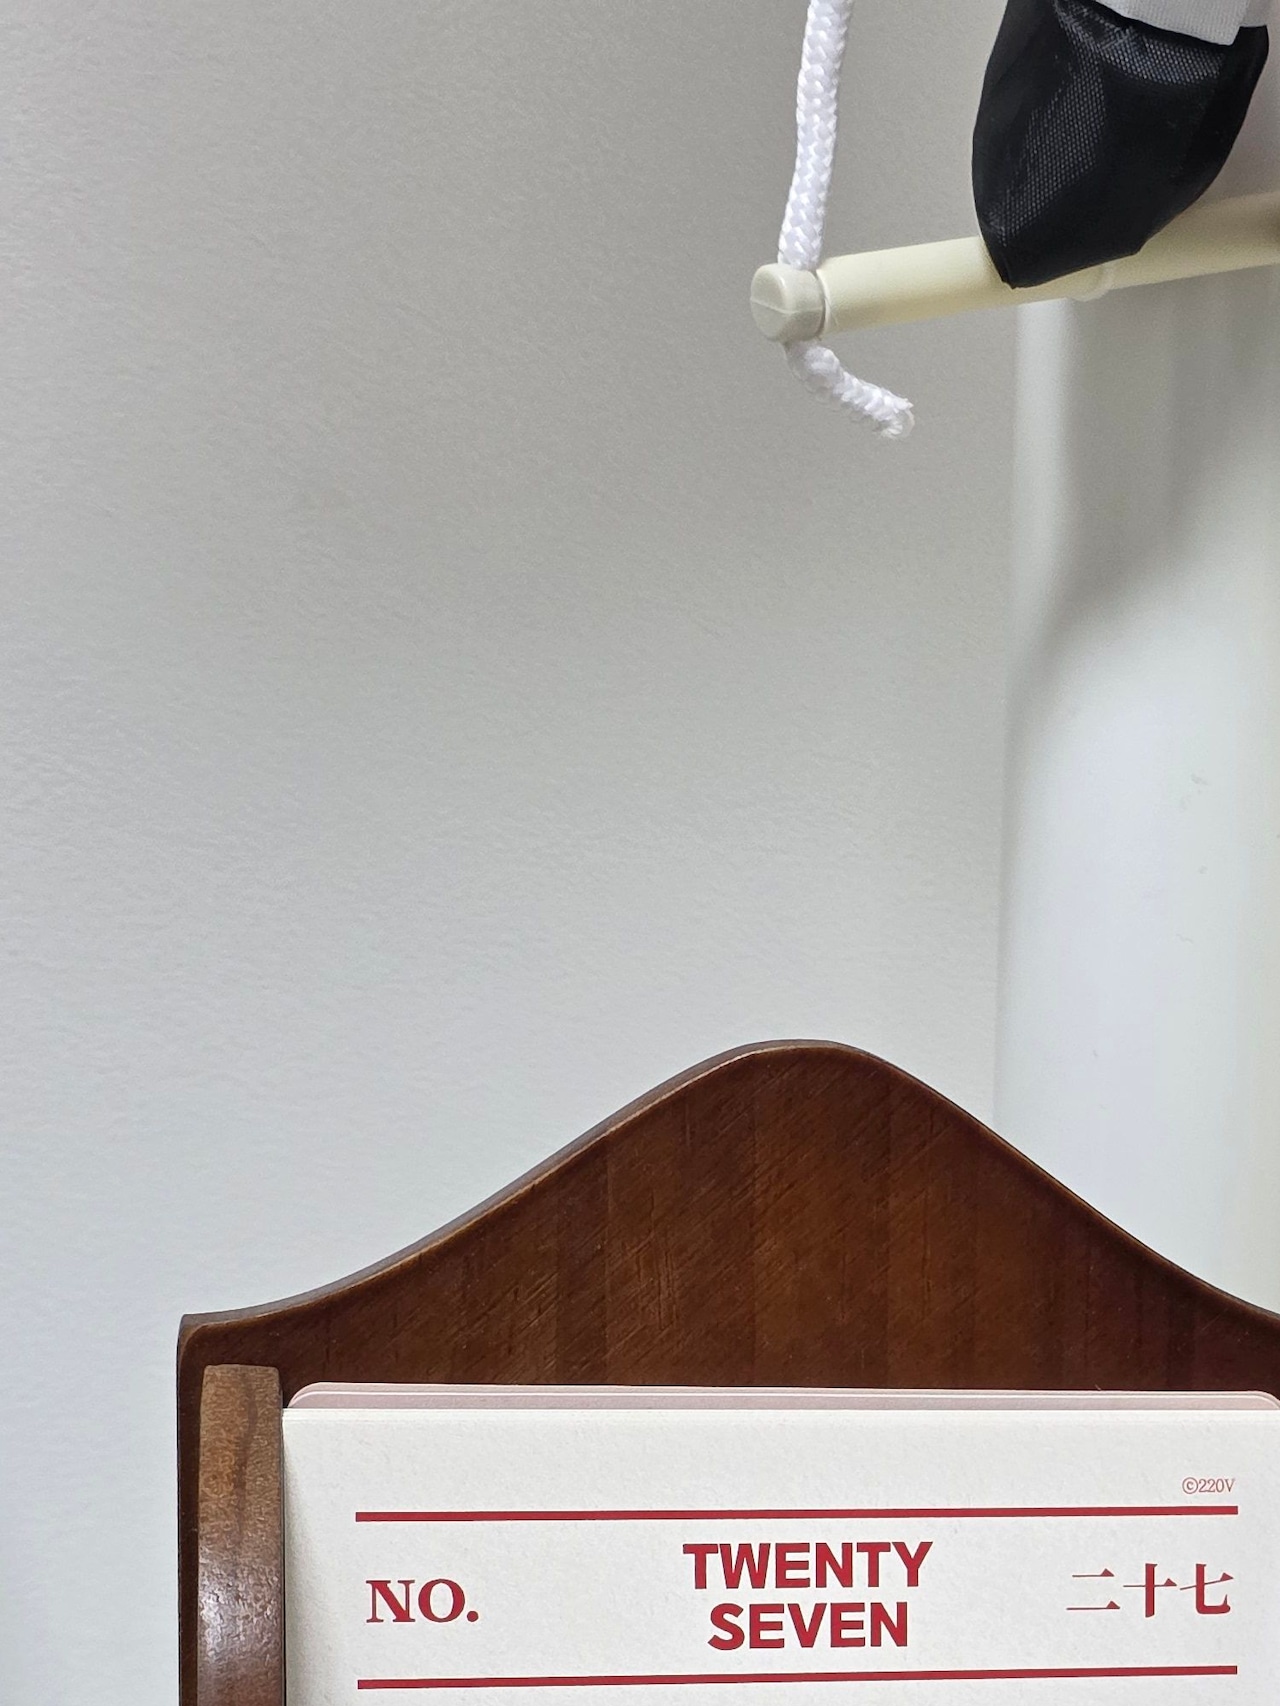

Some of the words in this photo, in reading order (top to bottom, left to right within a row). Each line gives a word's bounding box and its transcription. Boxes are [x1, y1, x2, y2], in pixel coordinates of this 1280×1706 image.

[683, 1541, 933, 1590] TWENTY
[1066, 1562, 1234, 1618] 二十七
[367, 1578, 480, 1624] NO.
[708, 1601, 909, 1651] SEVEN
